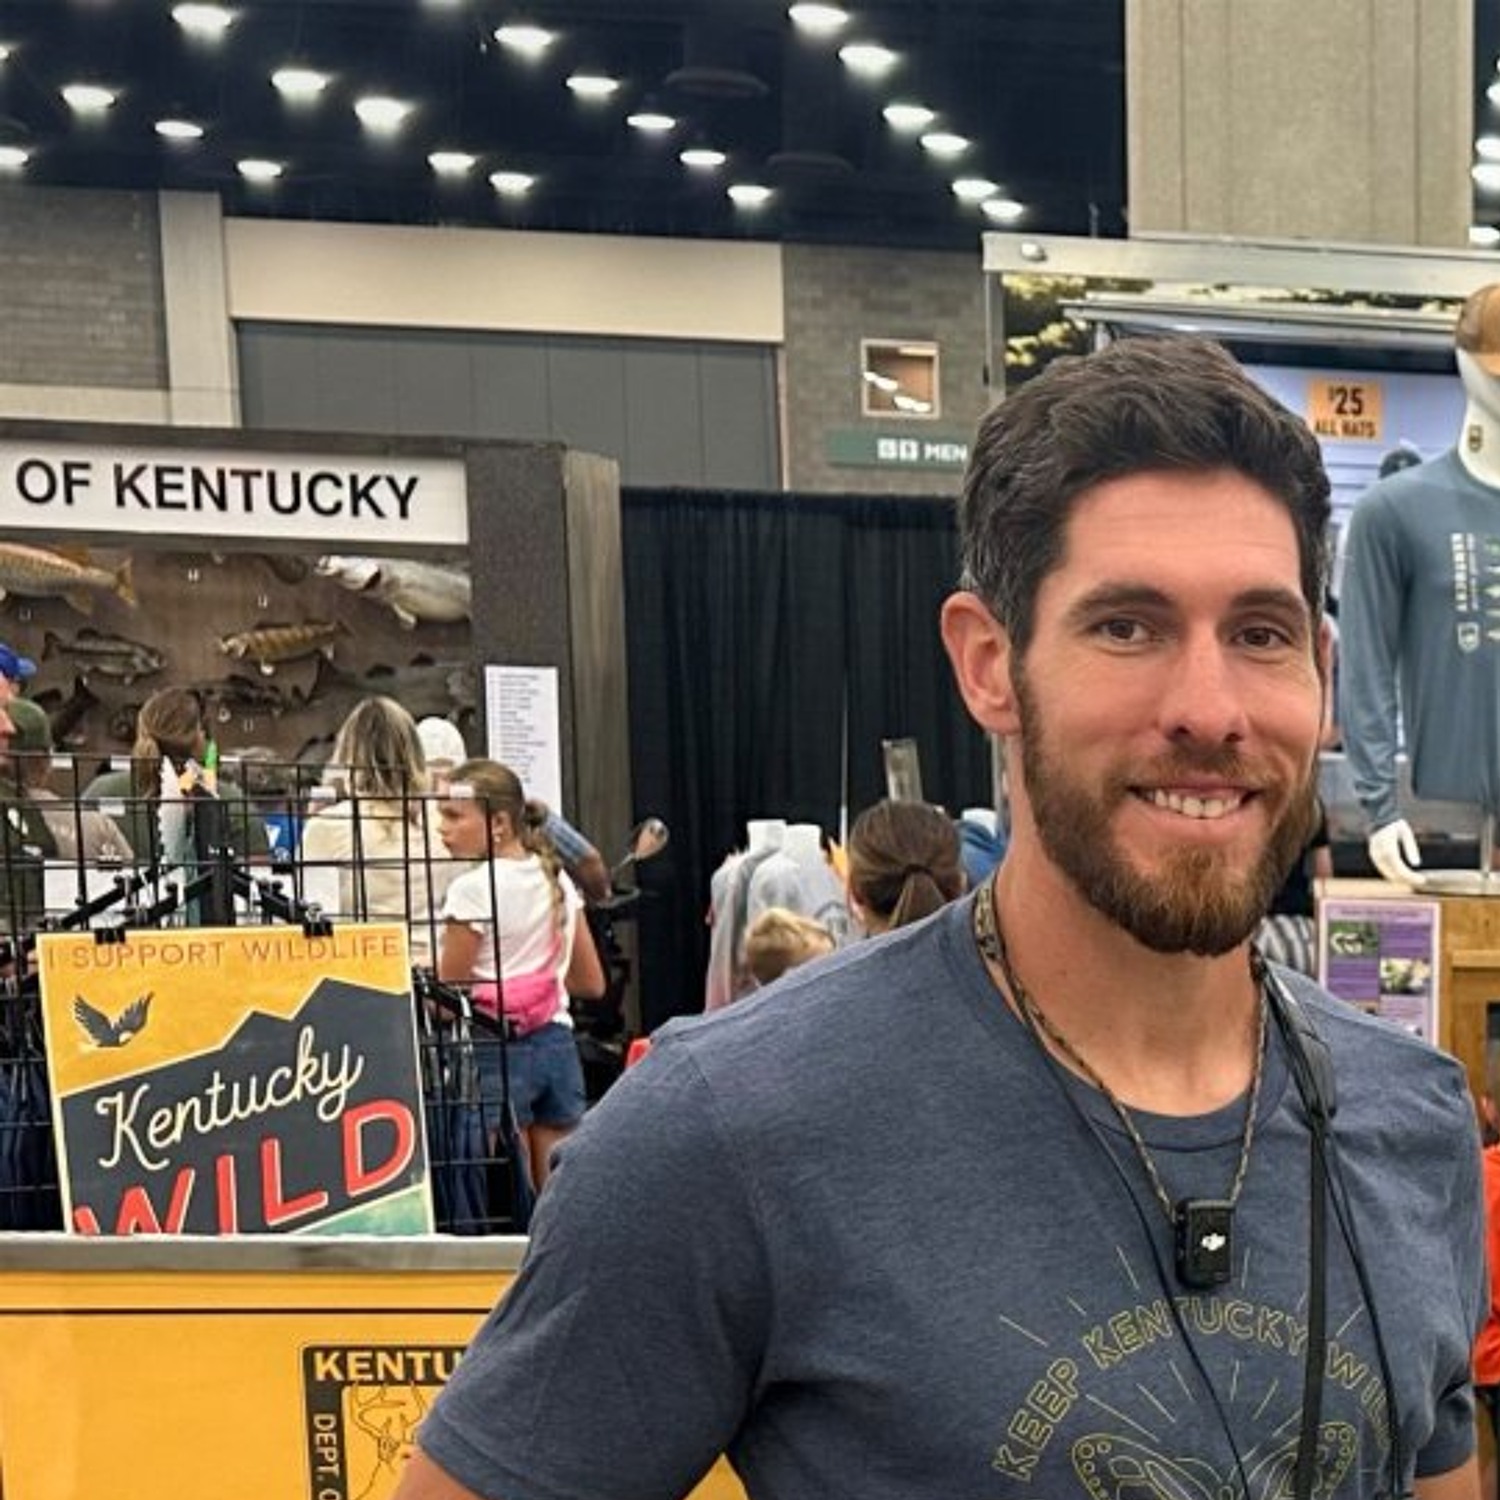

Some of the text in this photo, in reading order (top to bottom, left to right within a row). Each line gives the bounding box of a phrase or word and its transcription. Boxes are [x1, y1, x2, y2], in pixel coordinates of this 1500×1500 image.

[15, 459, 419, 520] OF KENTUCKY
[48, 935, 399, 970] I SUPPORT WILDLIFE
[95, 1025, 365, 1171] Kentucky
[72, 1099, 416, 1235] WILD
[313, 1350, 465, 1382] KENTU
[991, 1357, 1080, 1484] KEEP
[1082, 1296, 1309, 1371] KENTUCKY
[313, 1413, 340, 1482] DEPT.
